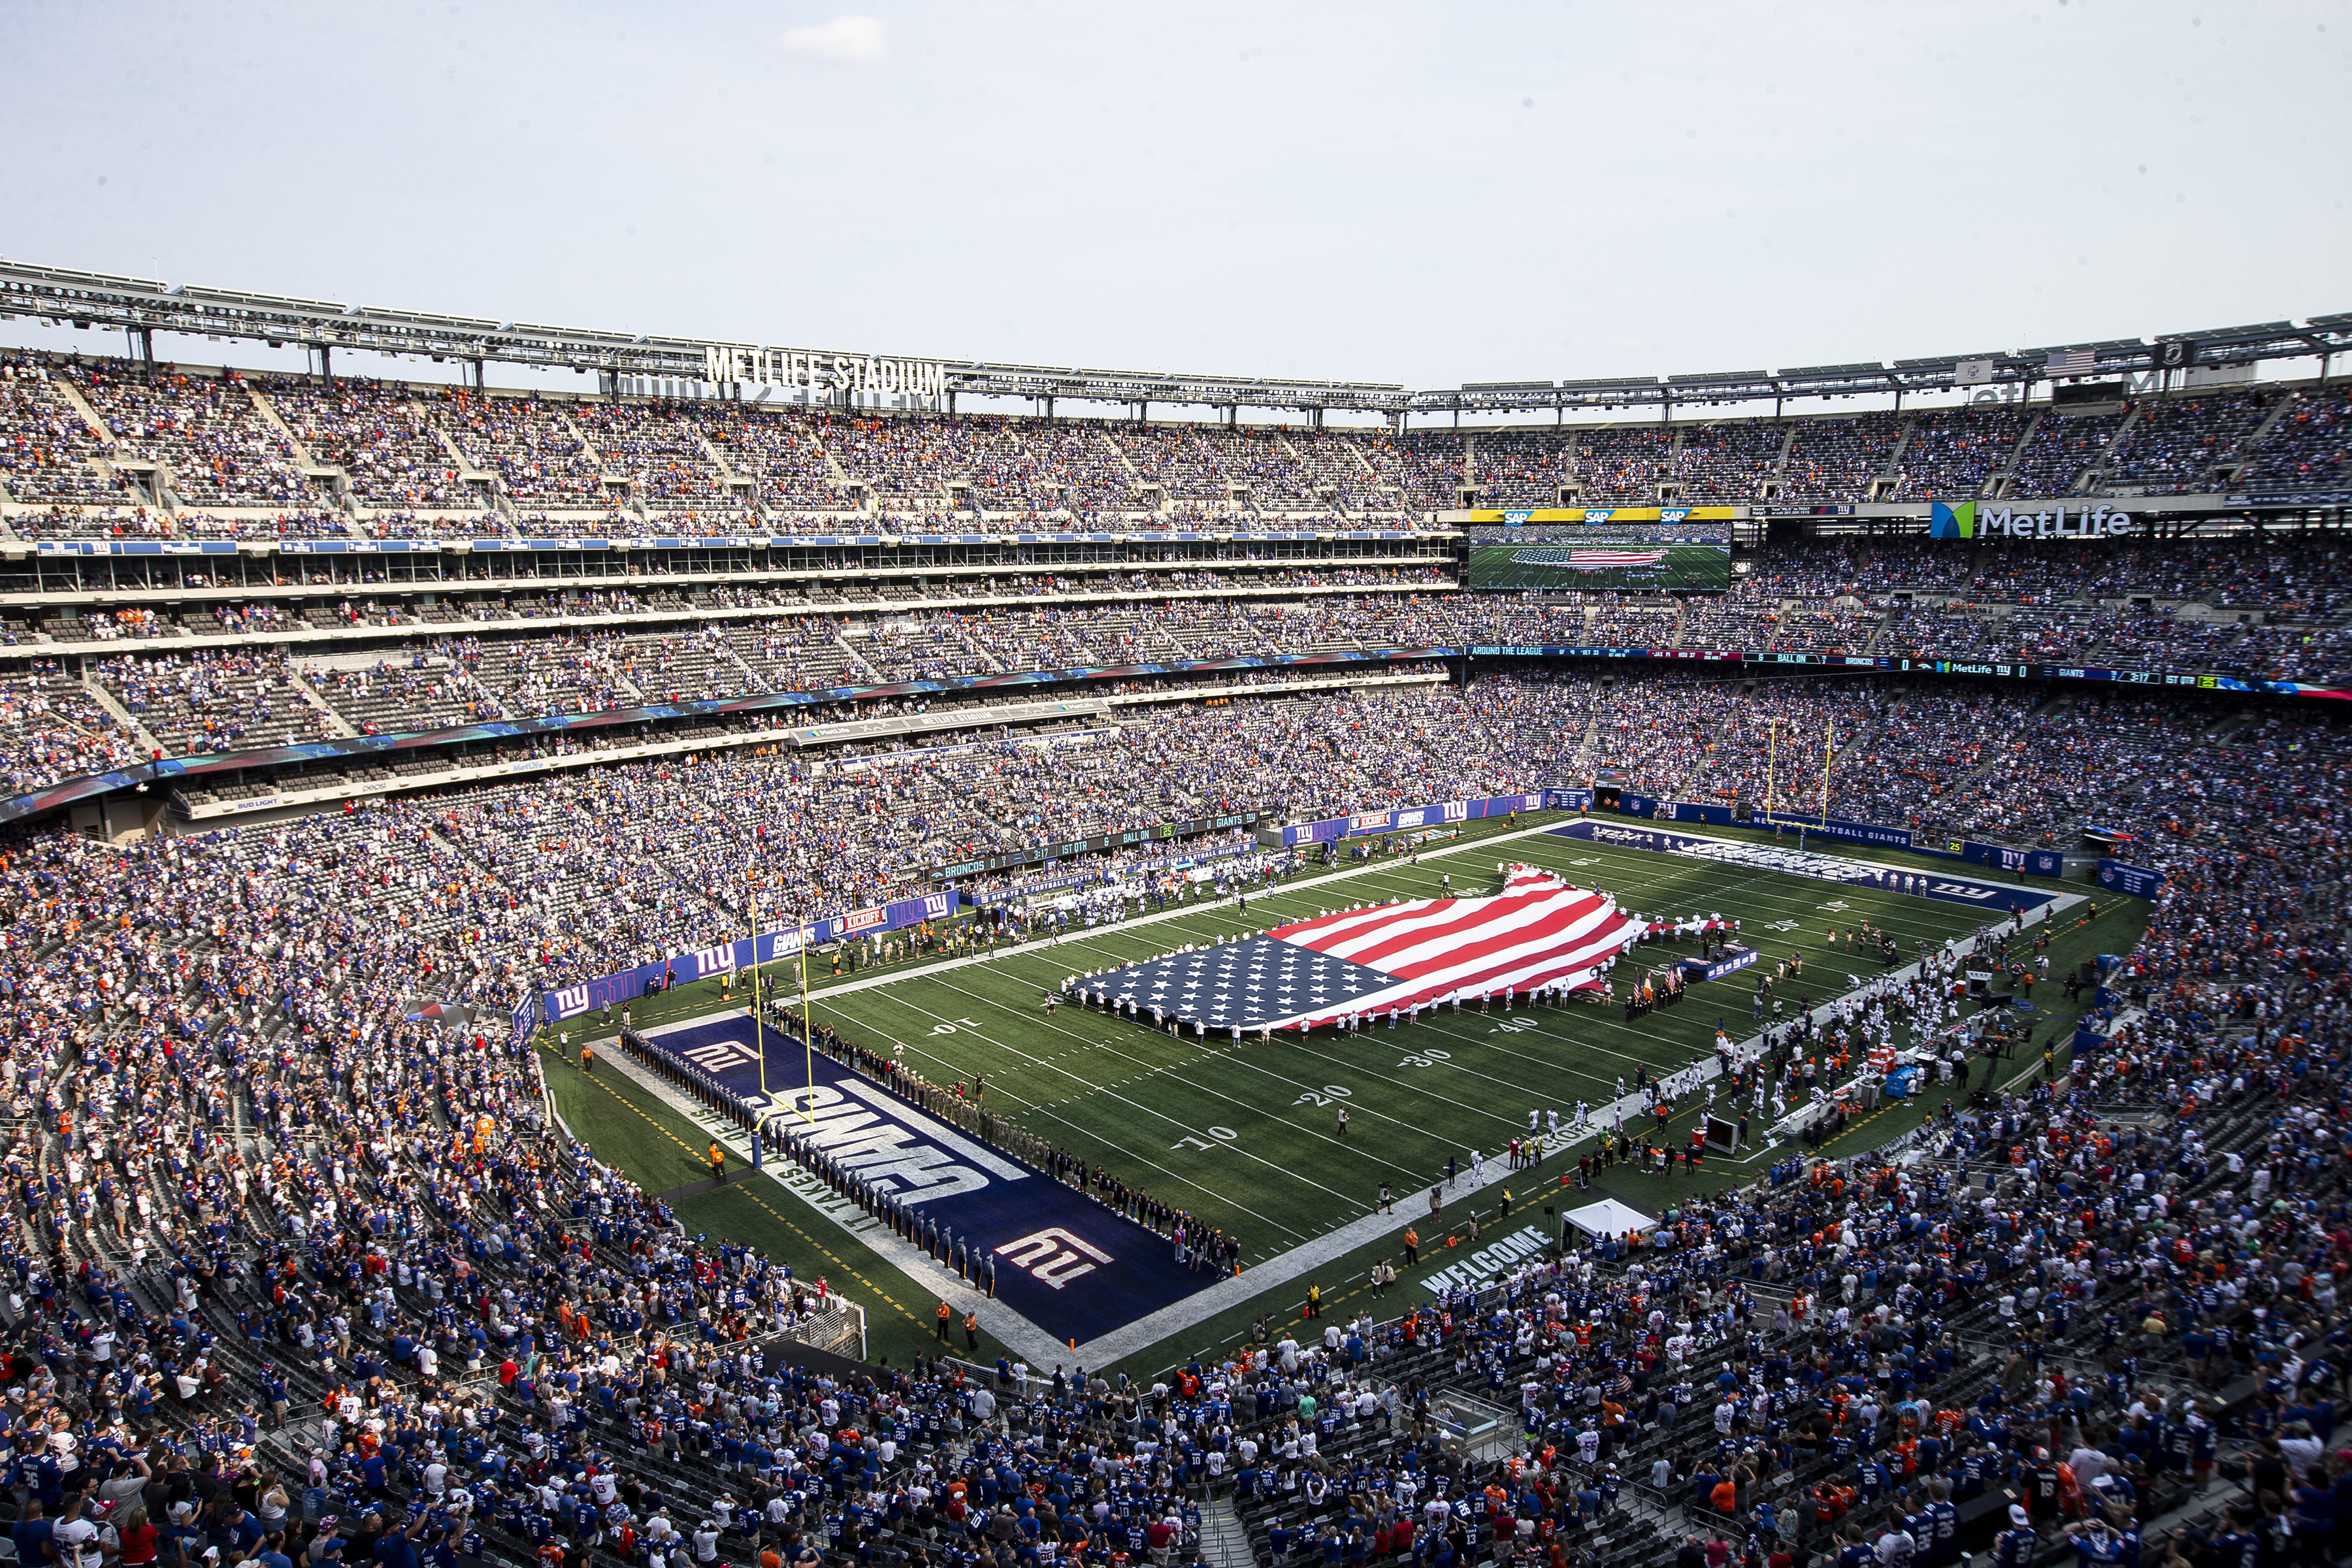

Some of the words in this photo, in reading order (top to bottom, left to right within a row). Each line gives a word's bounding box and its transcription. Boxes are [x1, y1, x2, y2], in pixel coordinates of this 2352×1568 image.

[706, 346, 825, 389] METLIFE
[832, 356, 945, 396] STADIUM
[1505, 513, 1527, 523] SAP
[1586, 512, 1609, 523] SAP
[1661, 511, 1685, 522] SAP
[1980, 504, 2131, 536] MetLife
[1472, 646, 1500, 655] AROUND
[1502, 647, 1515, 655] THE
[1516, 647, 1543, 655] LEAGUE
[1778, 654, 1795, 662] BALL
[1796, 655, 1806, 663] ON
[1845, 657, 1874, 666] BRONCOS
[1902, 659, 1909, 670] 0
[1952, 663, 1992, 674] MetLife
[1997, 665, 2011, 676] ny
[2019, 666, 2027, 678] 0
[2059, 668, 2085, 678] GIANTS
[2130, 673, 2149, 682] 3:17
[2165, 675, 2178, 684] 1ST
[2180, 676, 2195, 685] QTR
[921, 715, 955, 725] METLIFE
[956, 711, 994, 721] STADIUM
[819, 727, 851, 737] MetLife
[512, 761, 544, 772] MetLife
[363, 781, 387, 793] pepsi
[238, 801, 255, 809] BUD
[255, 798, 278, 808] LIGHT
[1525, 794, 1541, 810] ny
[1398, 810, 1425, 825] GIANTS
[1443, 800, 1467, 823] ny
[1207, 820, 1211, 829] 0
[1217, 815, 1242, 828] GIANTS
[1247, 813, 1256, 823] ny
[1361, 815, 1386, 826] KICKOFF
[1163, 826, 1172, 836] 25
[1295, 825, 1313, 843] ny
[1754, 816, 1775, 825] NEW
[1812, 823, 1864, 838] FOOTBALL
[1867, 831, 1907, 844] GIANTS
[1104, 837, 1109, 847] &
[1123, 832, 1139, 843] BALL
[1141, 830, 1150, 840] ON
[1062, 844, 1072, 855] 1ST
[1074, 840, 1088, 853] QTR
[1218, 846, 1241, 855] GIANTS
[1742, 842, 1773, 851] END
[1781, 847, 1857, 863] RACISM
[1950, 842, 1961, 851] 25
[1034, 847, 1049, 859] 3:17
[945, 860, 985, 877] BRONCOS
[990, 858, 996, 868] 0
[992, 892, 1007, 901] NEW
[1010, 887, 1028, 897] YOK
[1031, 879, 1065, 892] FOOTBALL
[1068, 874, 1093, 885] GIANTS
[1929, 883, 1998, 900] ny
[924, 894, 948, 919] ny
[1817, 900, 1850, 913] 10
[847, 910, 880, 928] KICKOFF
[1765, 918, 1800, 933] 20
[773, 927, 816, 953] GIANTS
[694, 942, 736, 979] ny
[555, 984, 589, 1019] ny
[932, 1017, 983, 1036] 10
[1500, 1017, 1539, 1034] 40
[682, 1040, 766, 1073] ny
[1405, 1047, 1452, 1069] 30
[1300, 1084, 1353, 1108] 20
[690, 1108, 724, 1125] US
[714, 1126, 748, 1142] OF
[1181, 1126, 1239, 1152] 10
[777, 1168, 850, 1215] TAKES
[842, 1215, 879, 1233] IT
[1594, 1241, 1603, 1250] 26
[993, 1227, 1115, 1290] ny
[1419, 1224, 1554, 1295] WELCOME
[734, 1293, 745, 1303] 89
[344, 1403, 354, 1414] 17
[822, 1407, 830, 1417] 10
[675, 1422, 686, 1431] 31
[1584, 1441, 1596, 1452] 56
[25, 1473, 39, 1488] 26
[1863, 1473, 1878, 1485] 26
[596, 1483, 607, 1494] 13
[808, 1484, 819, 1494] 26
[1074, 1483, 1084, 1494] 26
[2039, 1482, 2053, 1497] 18
[1458, 1503, 1470, 1515] 26
[579, 1514, 585, 1524] 8
[532, 1526, 538, 1536] 8
[1939, 1518, 1955, 1538] 26
[1129, 1538, 1141, 1549] 72
[1465, 1534, 1476, 1545] 13
